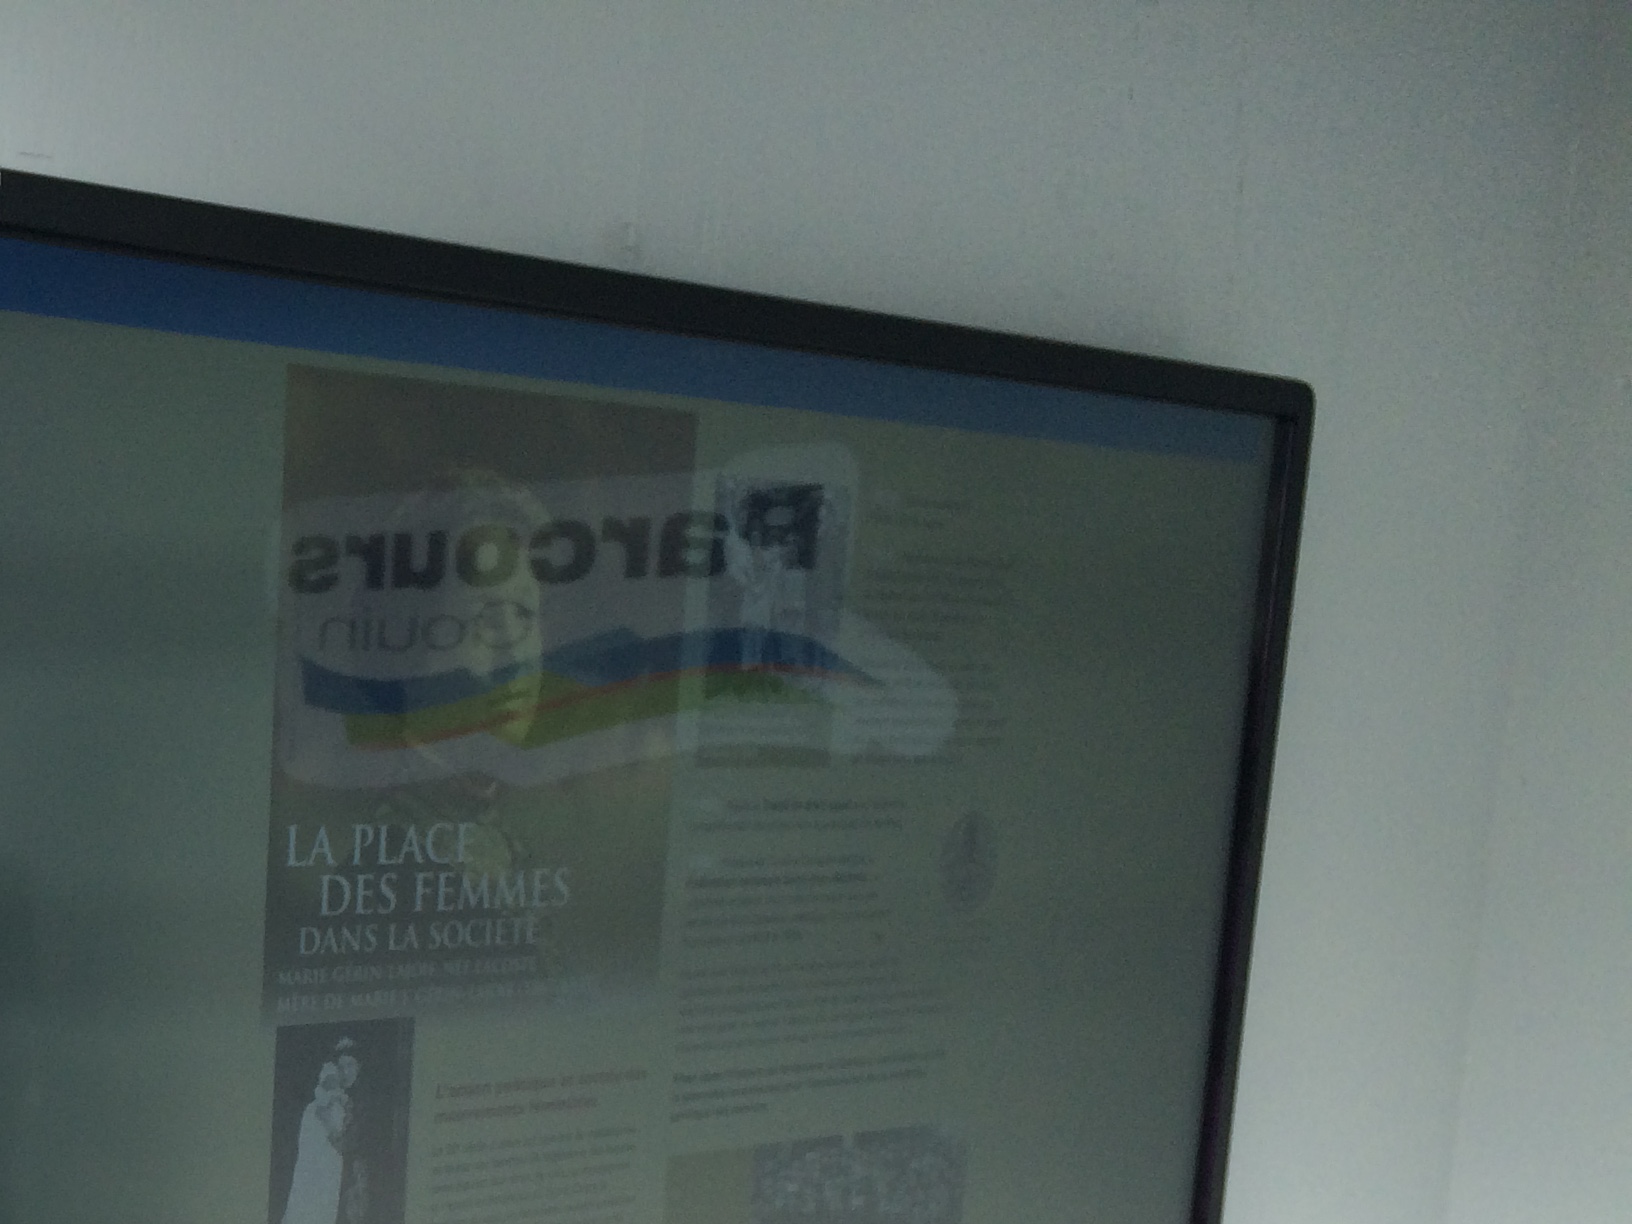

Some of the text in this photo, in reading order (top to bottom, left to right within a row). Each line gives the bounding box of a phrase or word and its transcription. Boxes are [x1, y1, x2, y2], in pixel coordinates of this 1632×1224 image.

[285, 823, 337, 868] LA
[319, 866, 572, 916] DES FEMMES
[298, 922, 379, 956] DANS
[387, 922, 420, 952] LA
